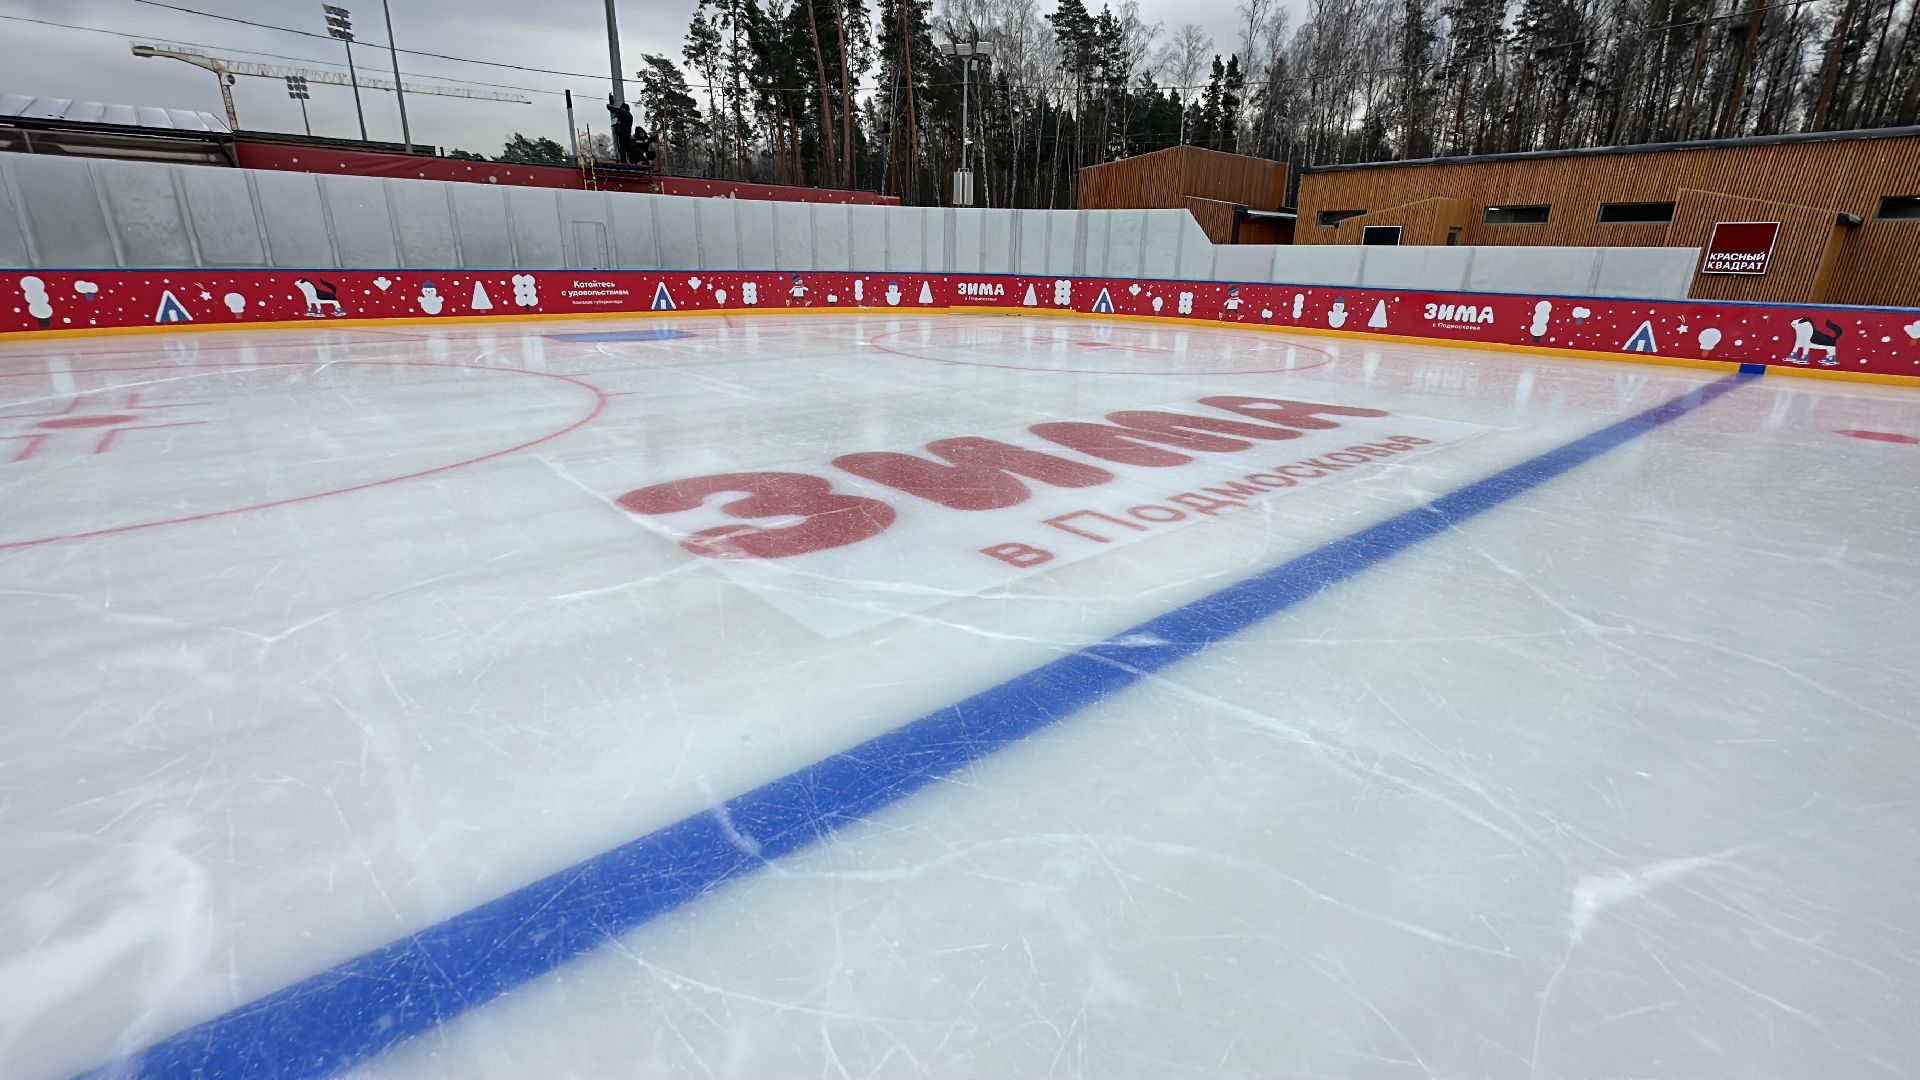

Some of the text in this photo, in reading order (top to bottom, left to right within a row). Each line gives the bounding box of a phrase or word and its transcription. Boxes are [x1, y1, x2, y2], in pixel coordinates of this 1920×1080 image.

[1709, 251, 1766, 261] КРАСНЫЙ
[1707, 261, 1764, 271] КВАДРАТ
[573, 280, 616, 288] Катайтесь
[957, 282, 1005, 296] ЗИМА
[568, 289, 629, 298] удовольствием
[1423, 303, 1494, 324] ЗИМА
[614, 394, 1390, 560] ЗИМА
[979, 435, 1433, 568] в Подмосковье
